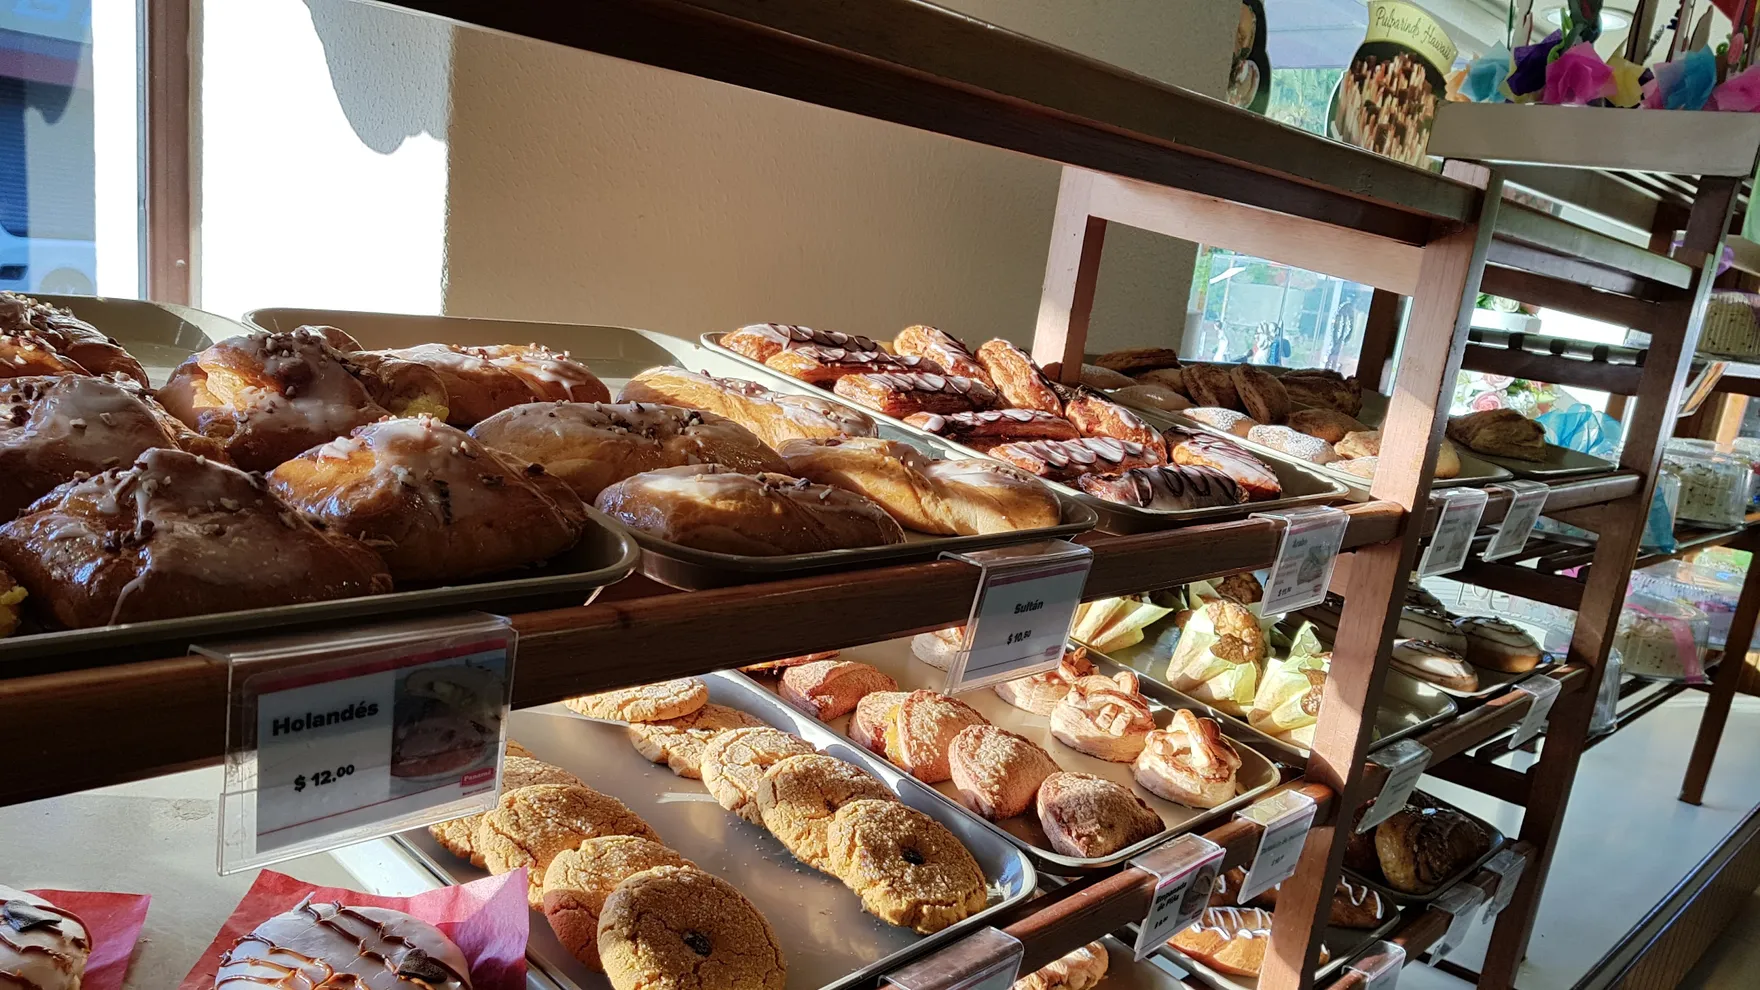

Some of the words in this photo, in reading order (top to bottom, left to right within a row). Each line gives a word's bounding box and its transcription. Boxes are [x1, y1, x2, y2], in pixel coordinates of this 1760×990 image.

[1421, 24, 1452, 60] Hawaii
[1014, 599, 1044, 614] Sultán
[1014, 630, 1032, 643] 10.50
[272, 701, 379, 736] Holandés
[294, 774, 306, 792] $
[311, 764, 355, 786] 12.00
